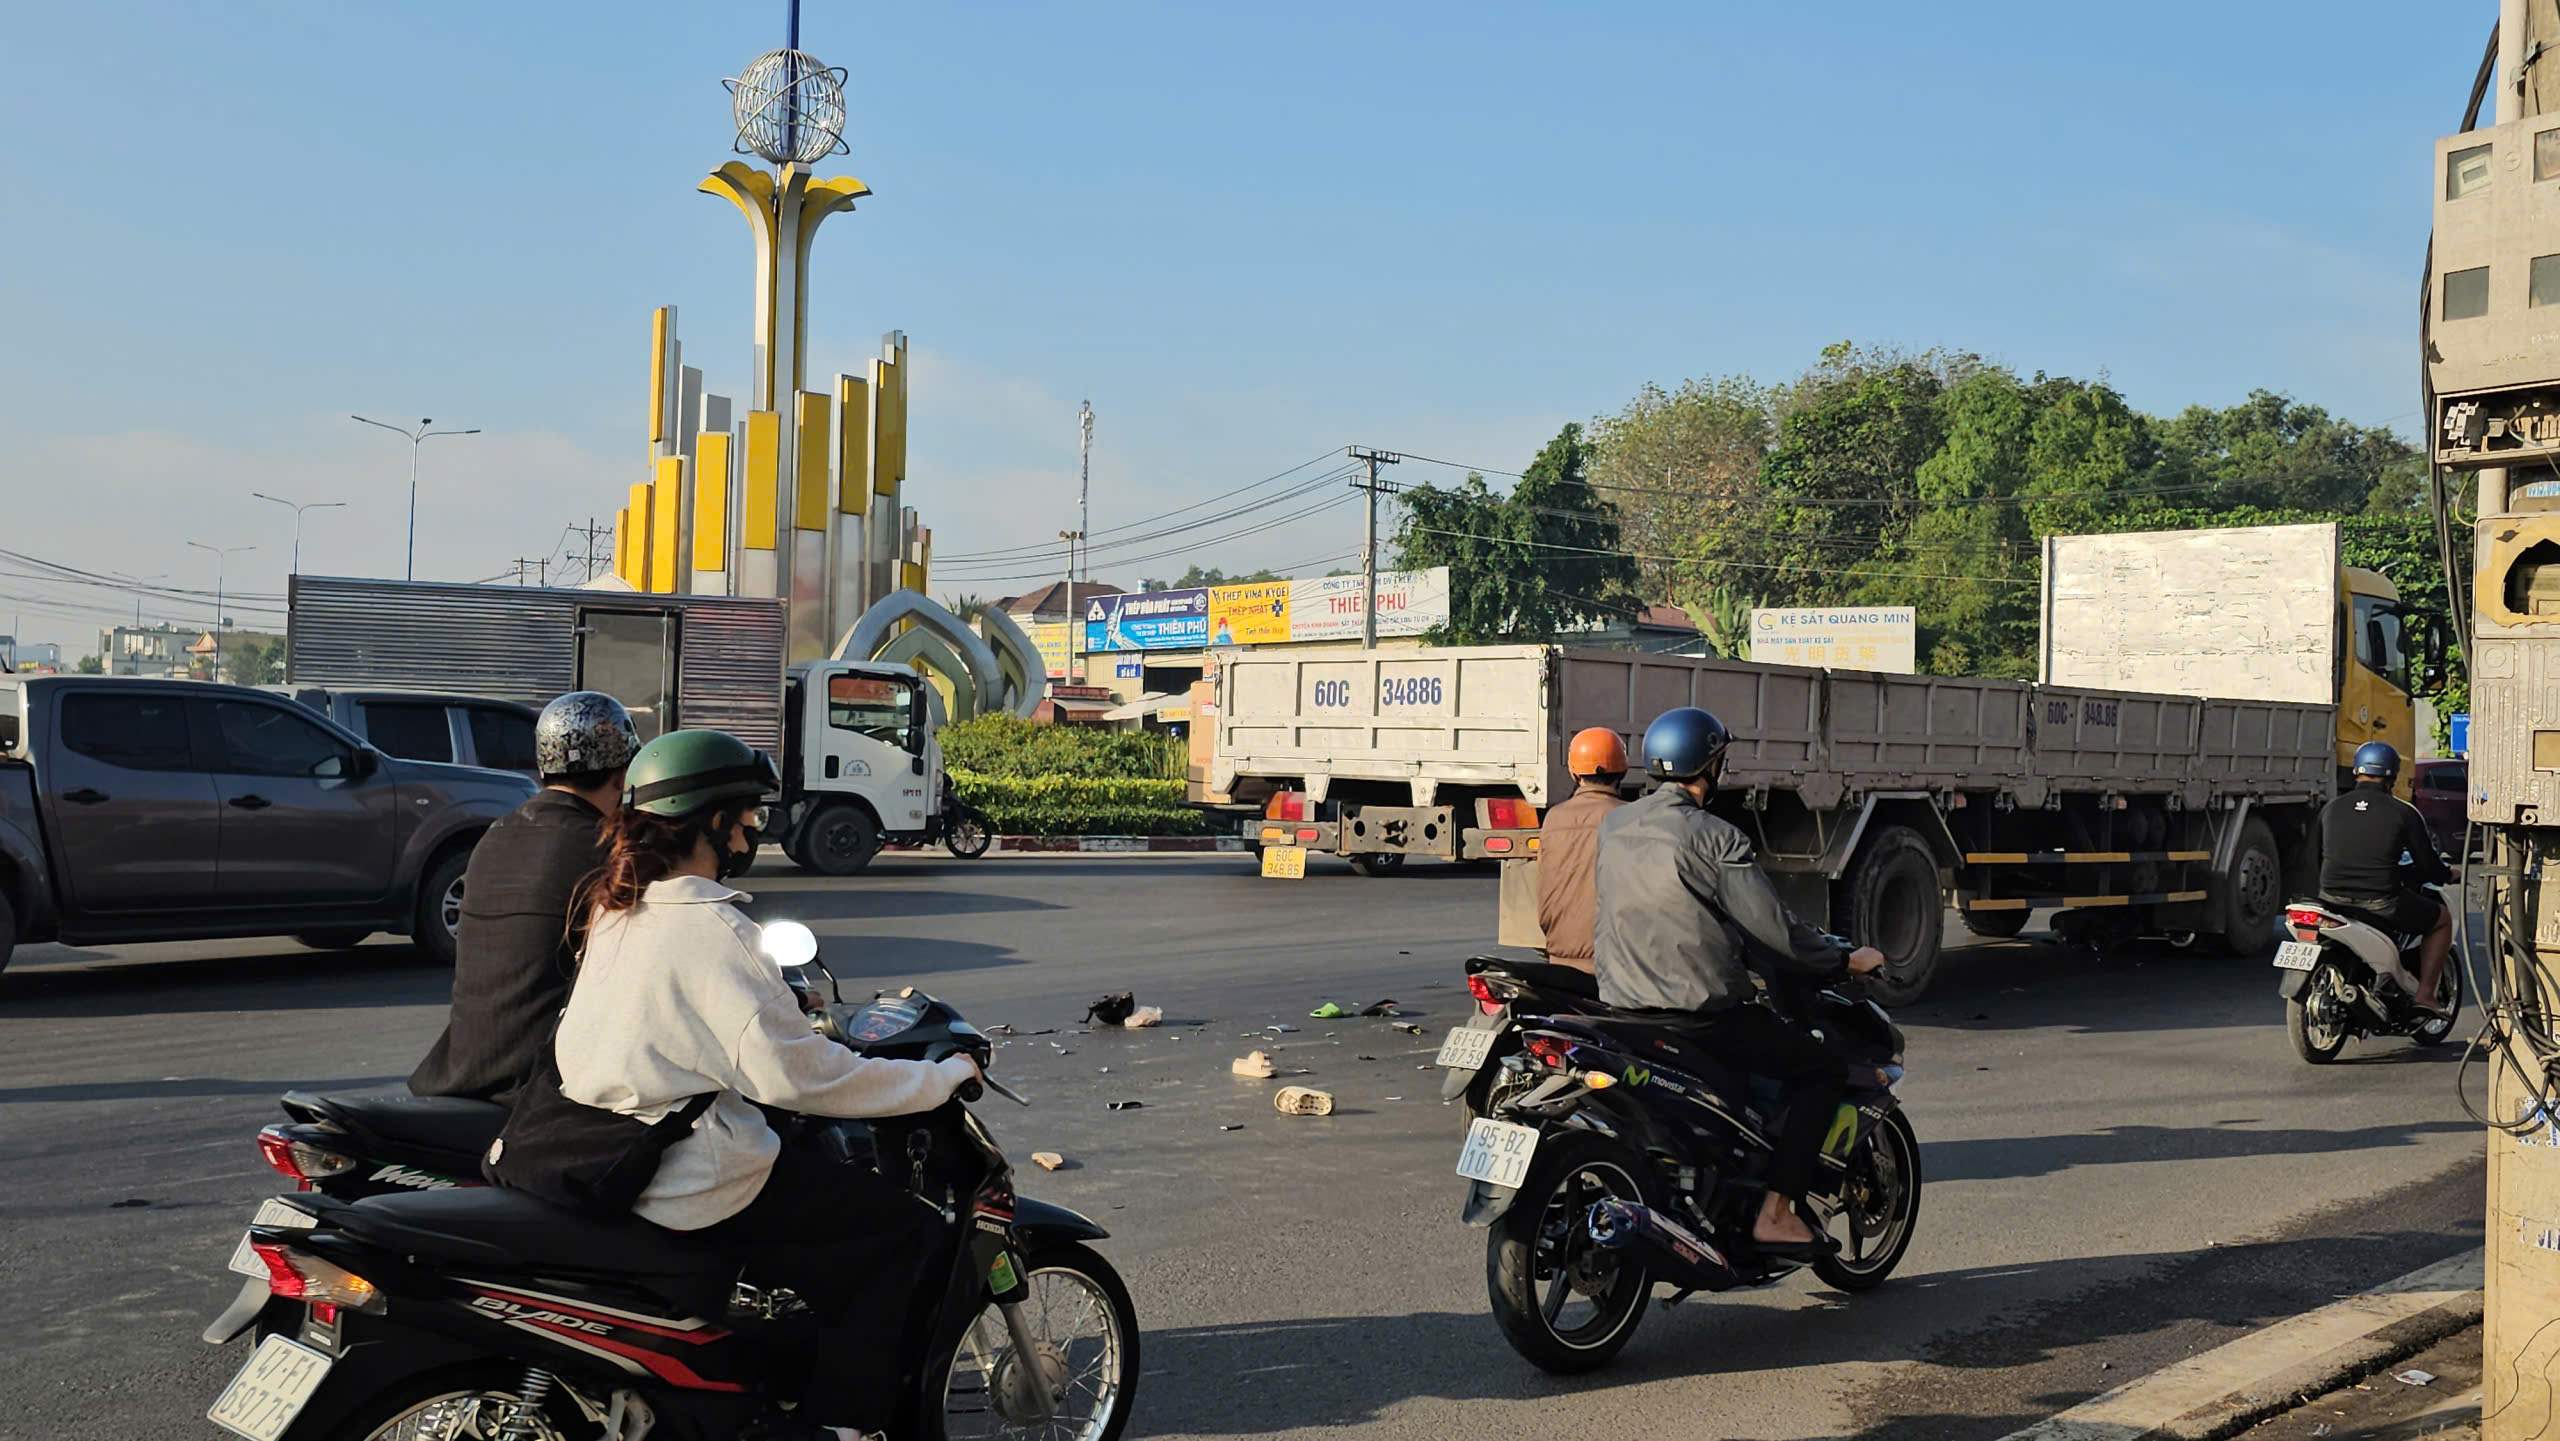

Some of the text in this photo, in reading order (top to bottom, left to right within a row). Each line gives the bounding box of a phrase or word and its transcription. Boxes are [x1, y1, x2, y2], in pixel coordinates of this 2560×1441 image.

[1244, 588, 1262, 600] VINA
[1265, 586, 1289, 599] KYOEI
[1157, 618, 1185, 635] THIÊN
[1186, 616, 1207, 634] PHÚ
[1829, 614, 1879, 624] QUANG
[1315, 677, 1442, 707] 60C 34886
[2048, 702, 2068, 724] 60C
[1276, 850, 1295, 862] 60C
[1267, 863, 1300, 875] 348.86
[2285, 944, 2313, 956] 83-AA
[2277, 955, 2313, 968] 368.04
[1453, 1031, 1488, 1049] 61-C1
[1441, 1047, 1484, 1066] 387.59
[1650, 1074, 1686, 1095] movistar
[1478, 1125, 1527, 1156] 95-B2
[1462, 1149, 1524, 1182] 107.11
[976, 1219, 1005, 1236] HONDA
[472, 1296, 614, 1335] BLADE
[256, 1345, 318, 1396] 47-F1
[219, 1381, 295, 1438] 697.75
